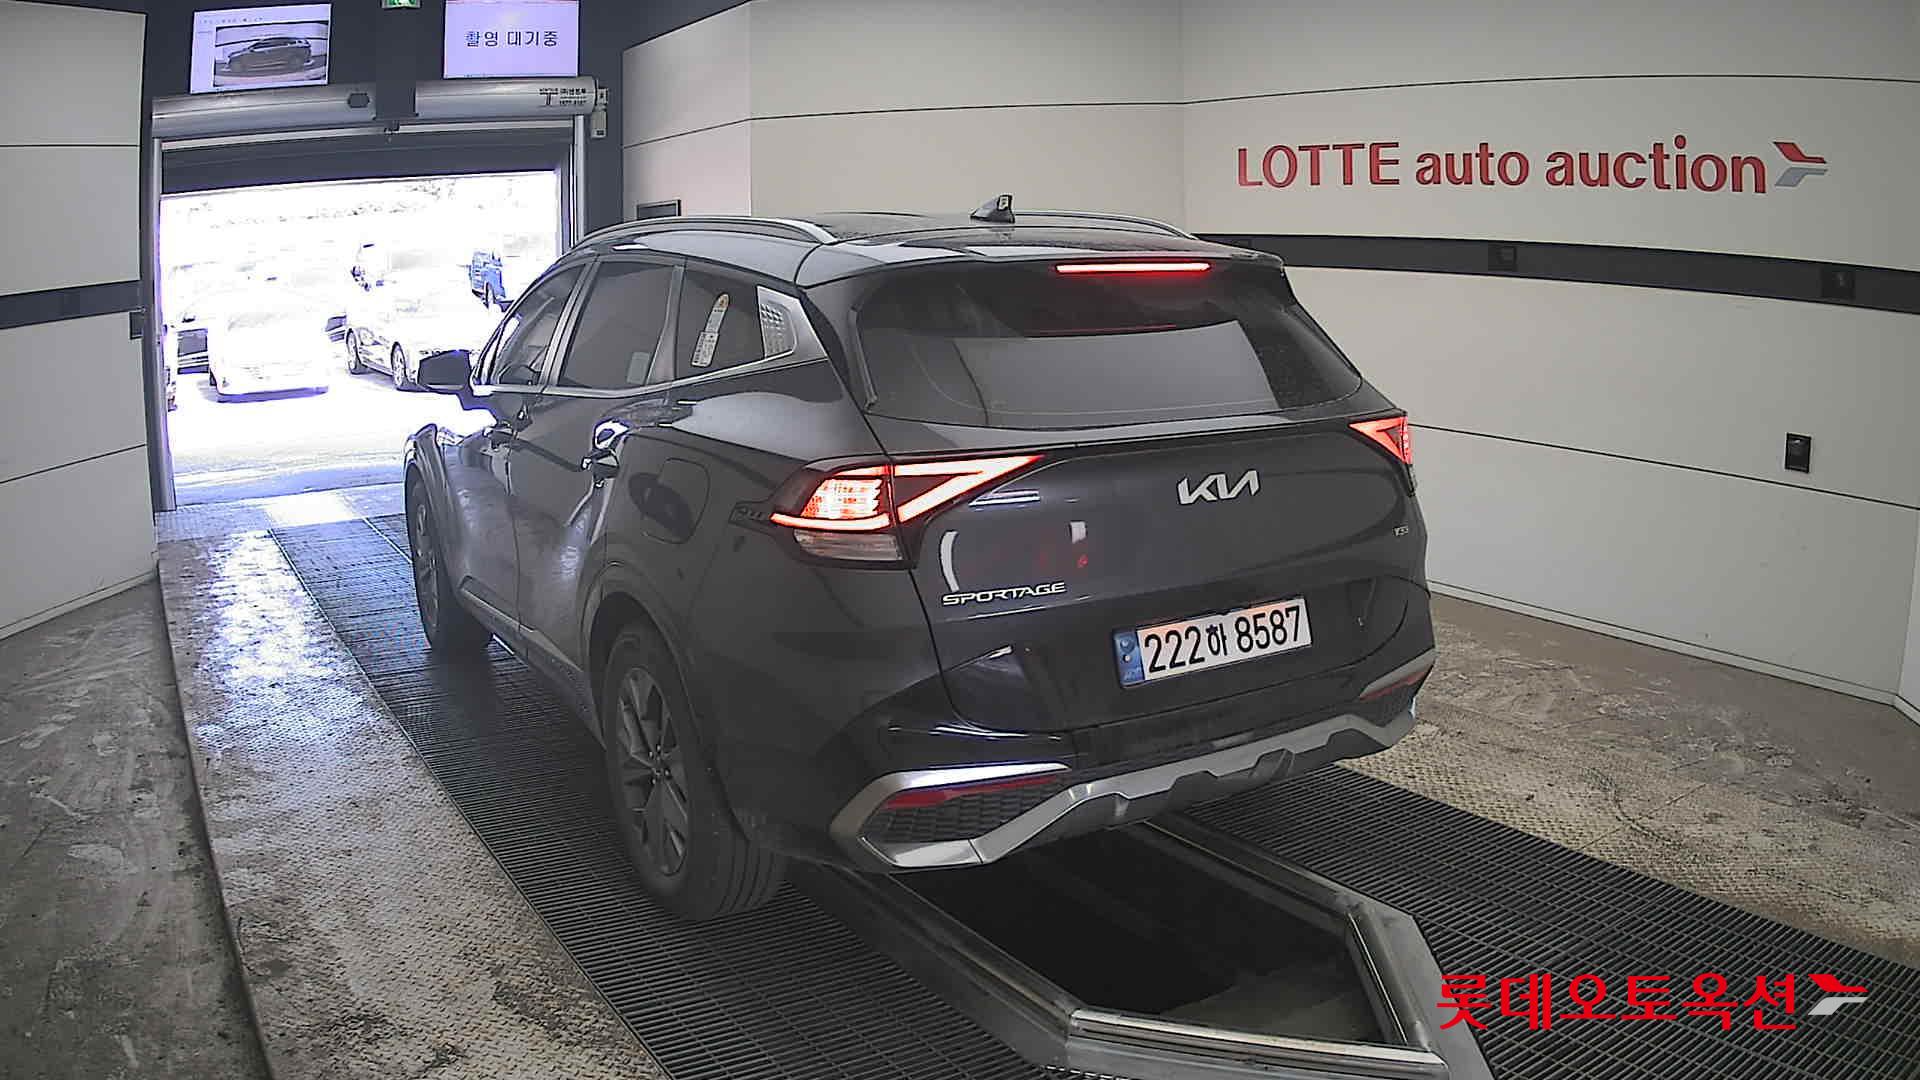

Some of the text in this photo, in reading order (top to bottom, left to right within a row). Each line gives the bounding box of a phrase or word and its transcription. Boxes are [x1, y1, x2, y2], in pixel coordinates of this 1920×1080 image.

[507, 30, 558, 47] 대기중
[1237, 134, 1768, 194] LOTTE auto auction
[942, 581, 1067, 606] SPORTAGE
[1234, 605, 1301, 654] 8587
